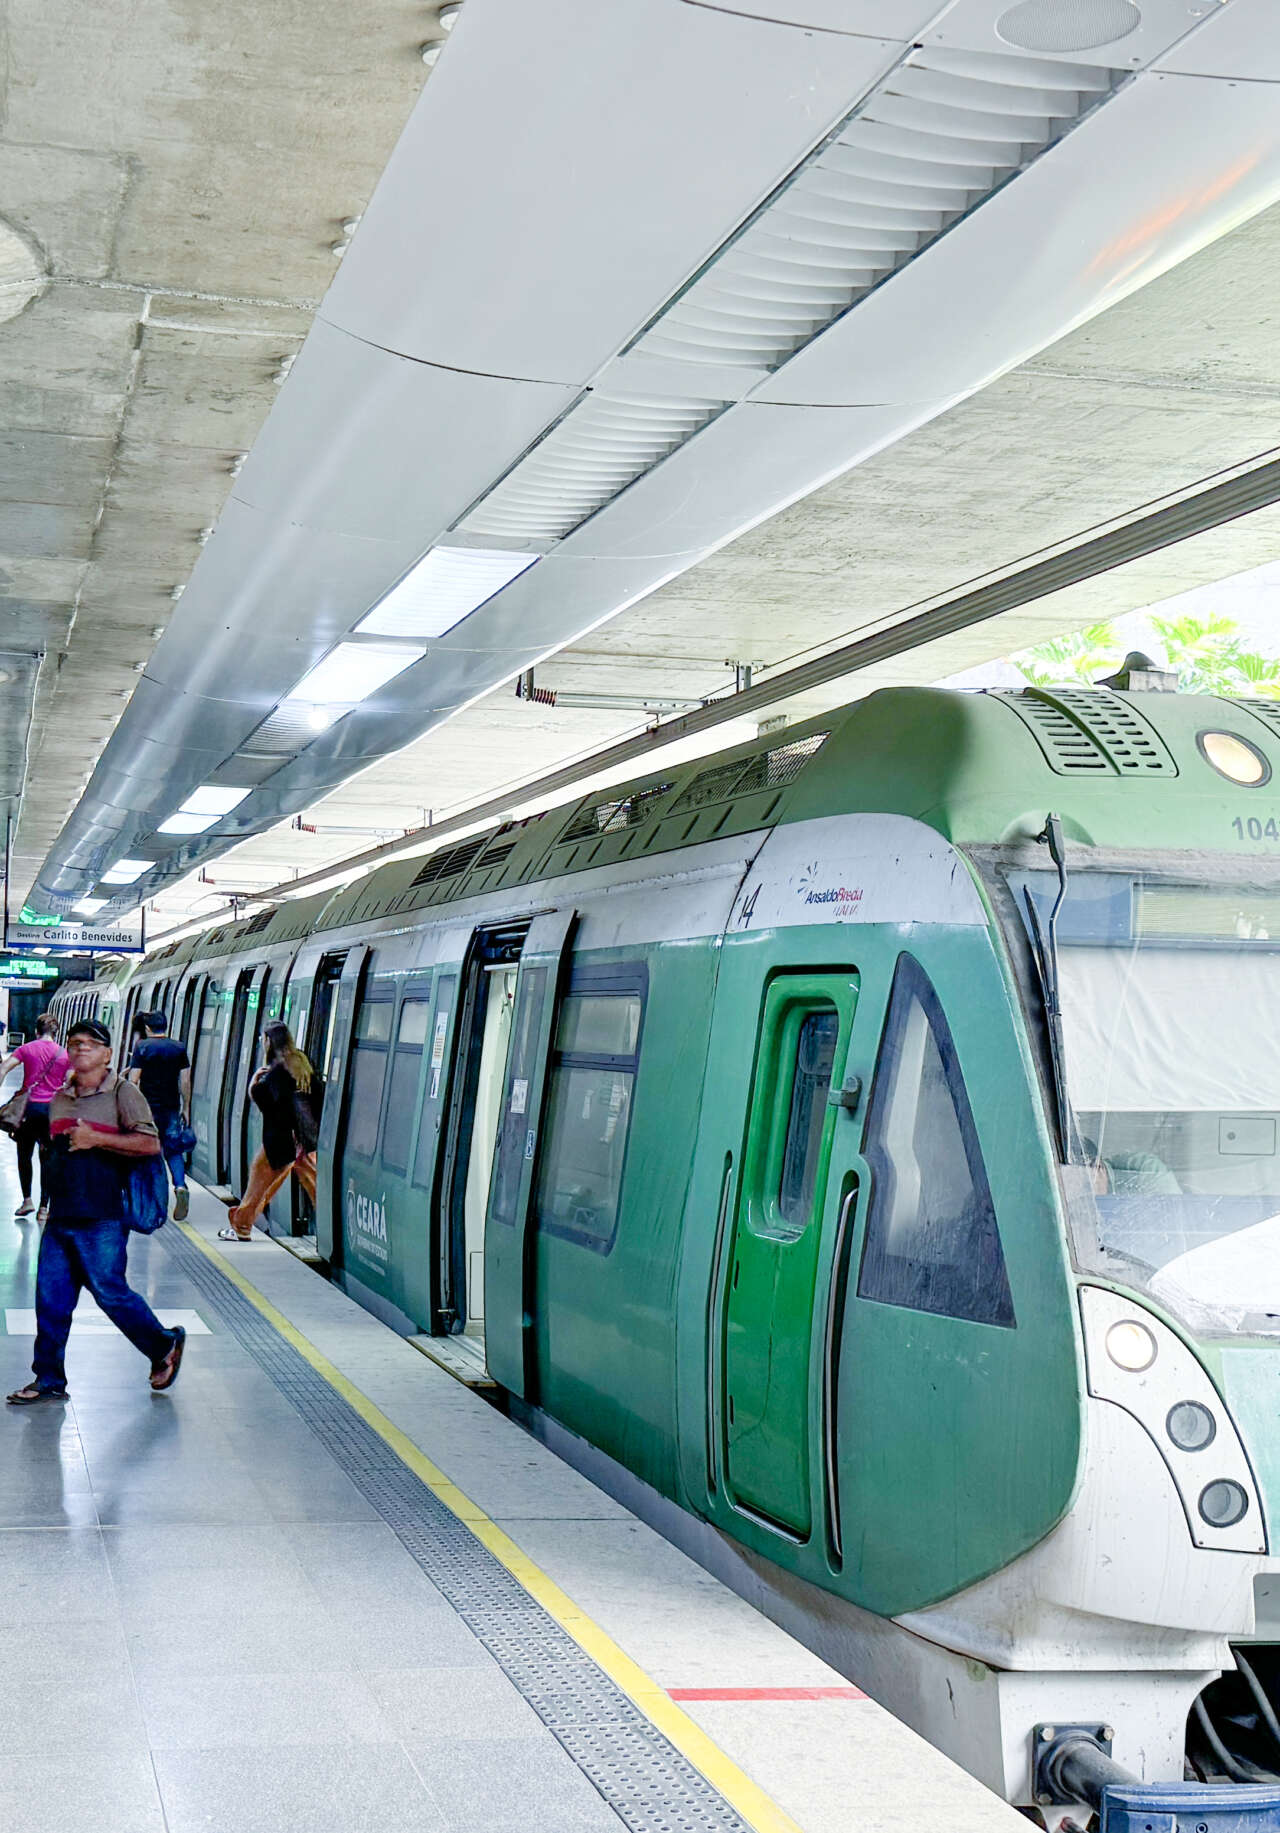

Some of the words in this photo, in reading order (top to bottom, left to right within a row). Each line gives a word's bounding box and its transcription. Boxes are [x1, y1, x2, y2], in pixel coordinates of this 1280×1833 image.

[1231, 816, 1280, 841] 104
[43, 929, 78, 940] Carlito
[81, 930, 133, 943] Benevides
[356, 1191, 388, 1243] CEARÁ
